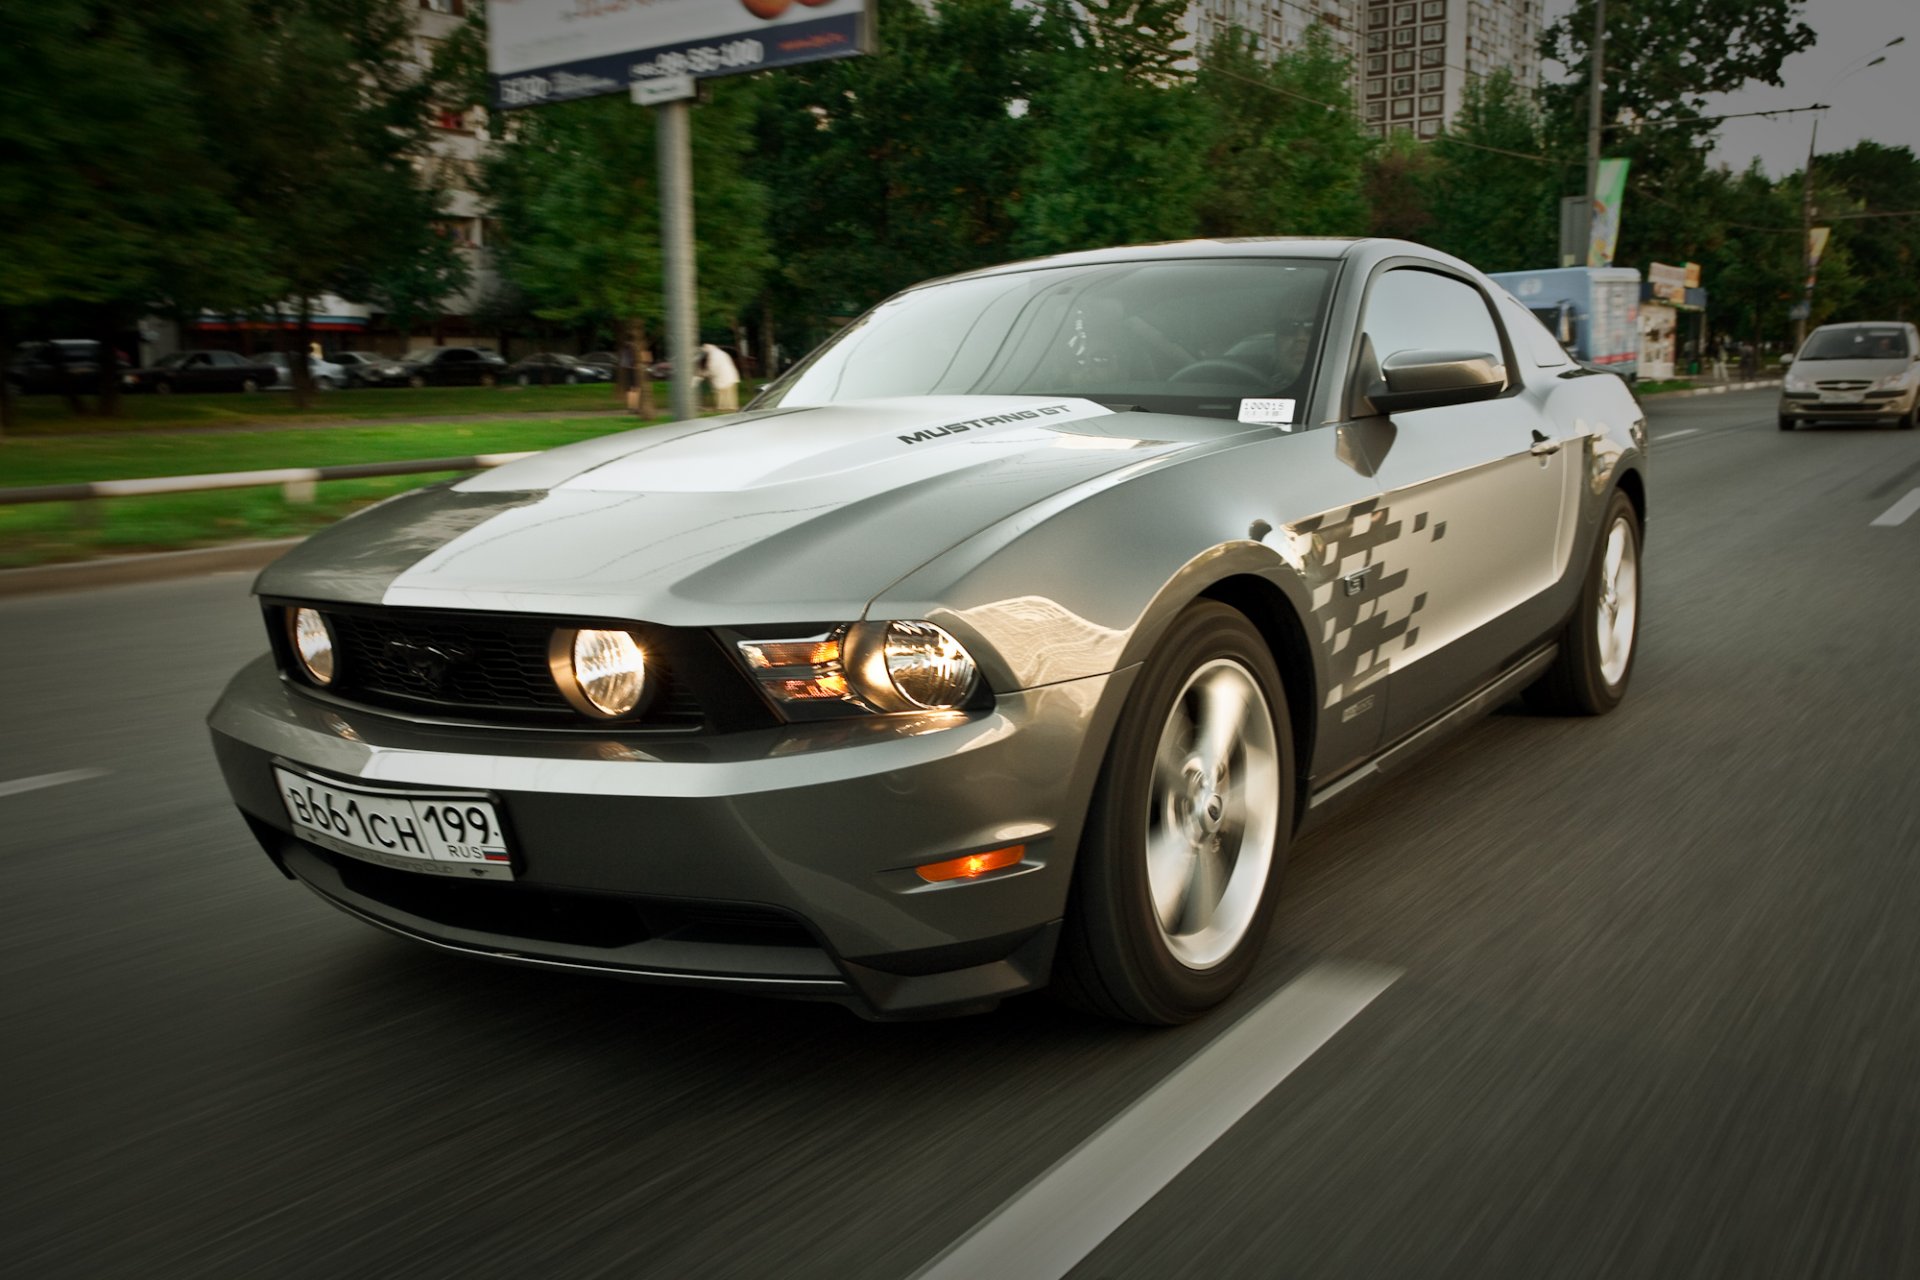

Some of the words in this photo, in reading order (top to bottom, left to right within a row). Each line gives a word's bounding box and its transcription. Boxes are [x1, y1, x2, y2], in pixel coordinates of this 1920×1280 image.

[897, 410, 1040, 445] MUSTANG
[1036, 404, 1071, 416] GT
[288, 786, 425, 854] B661CH
[423, 805, 490, 844] 199
[448, 845, 483, 860] RUS
